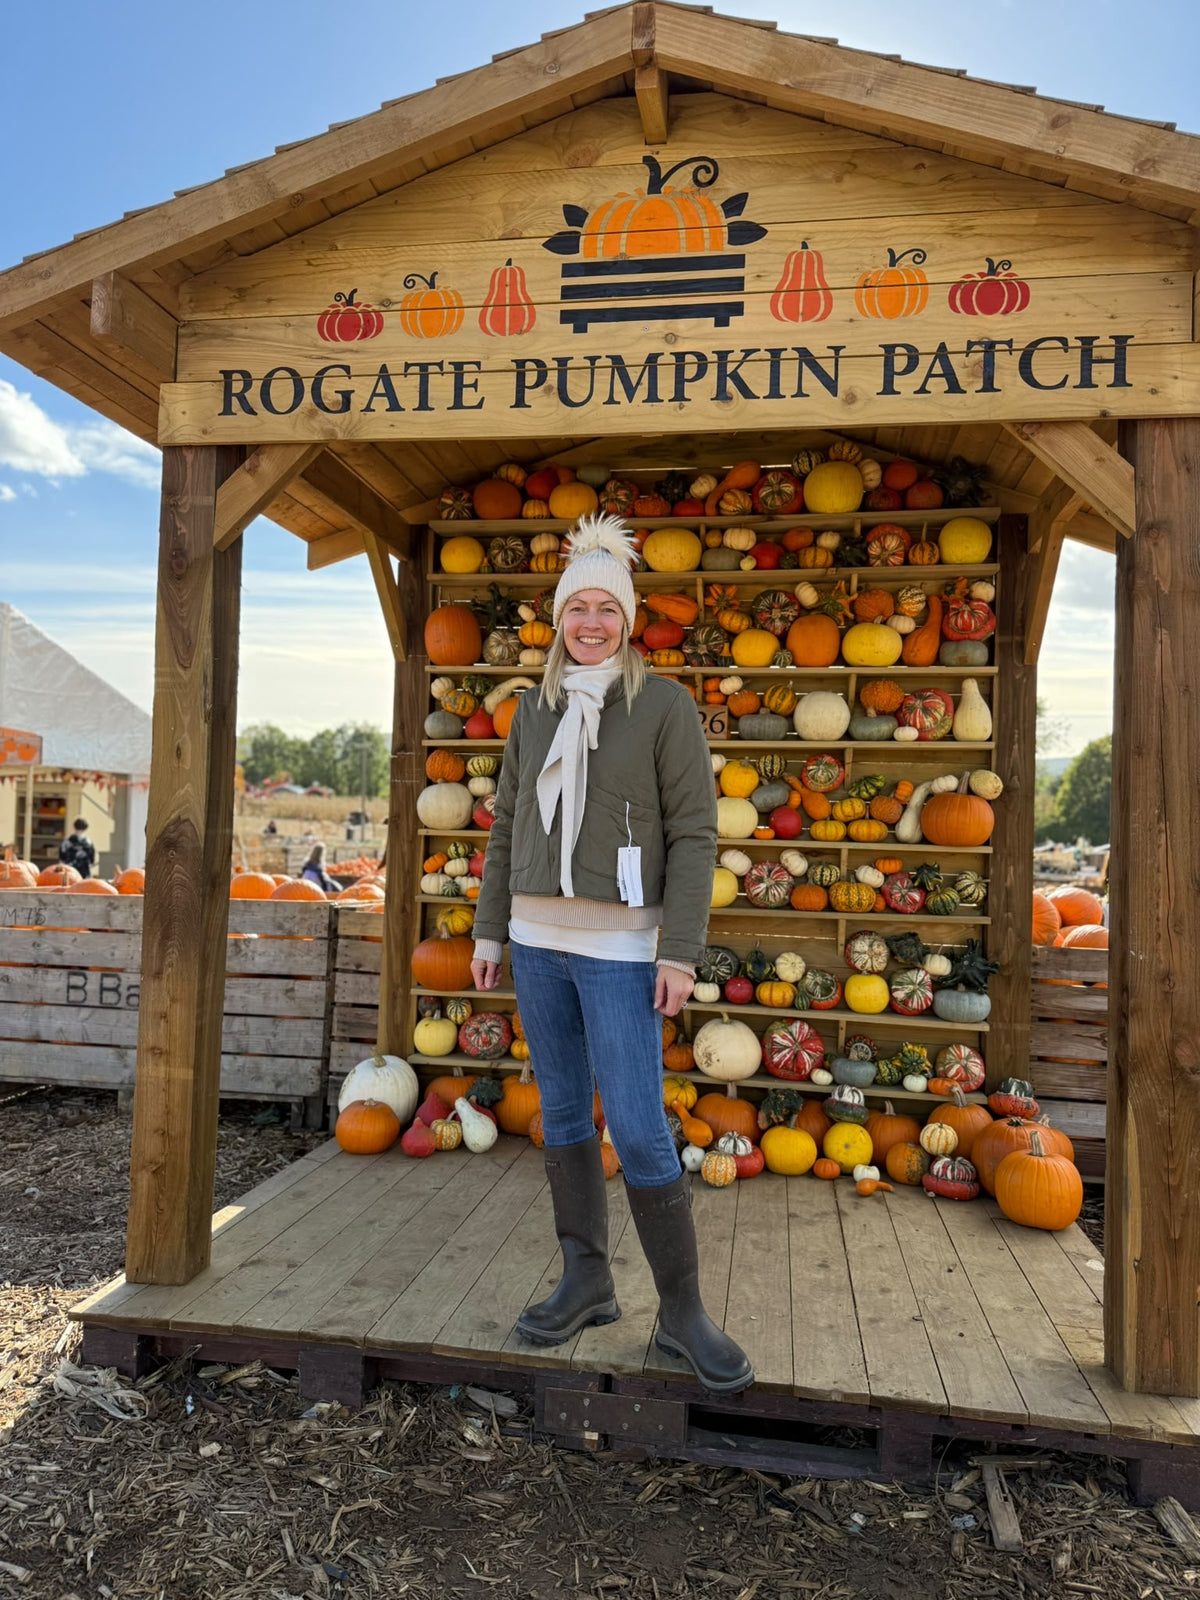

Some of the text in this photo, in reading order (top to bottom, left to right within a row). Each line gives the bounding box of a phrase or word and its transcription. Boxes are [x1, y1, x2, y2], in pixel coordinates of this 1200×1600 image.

[218, 335, 1135, 416] ROGATE PUMPKIN PATCH
